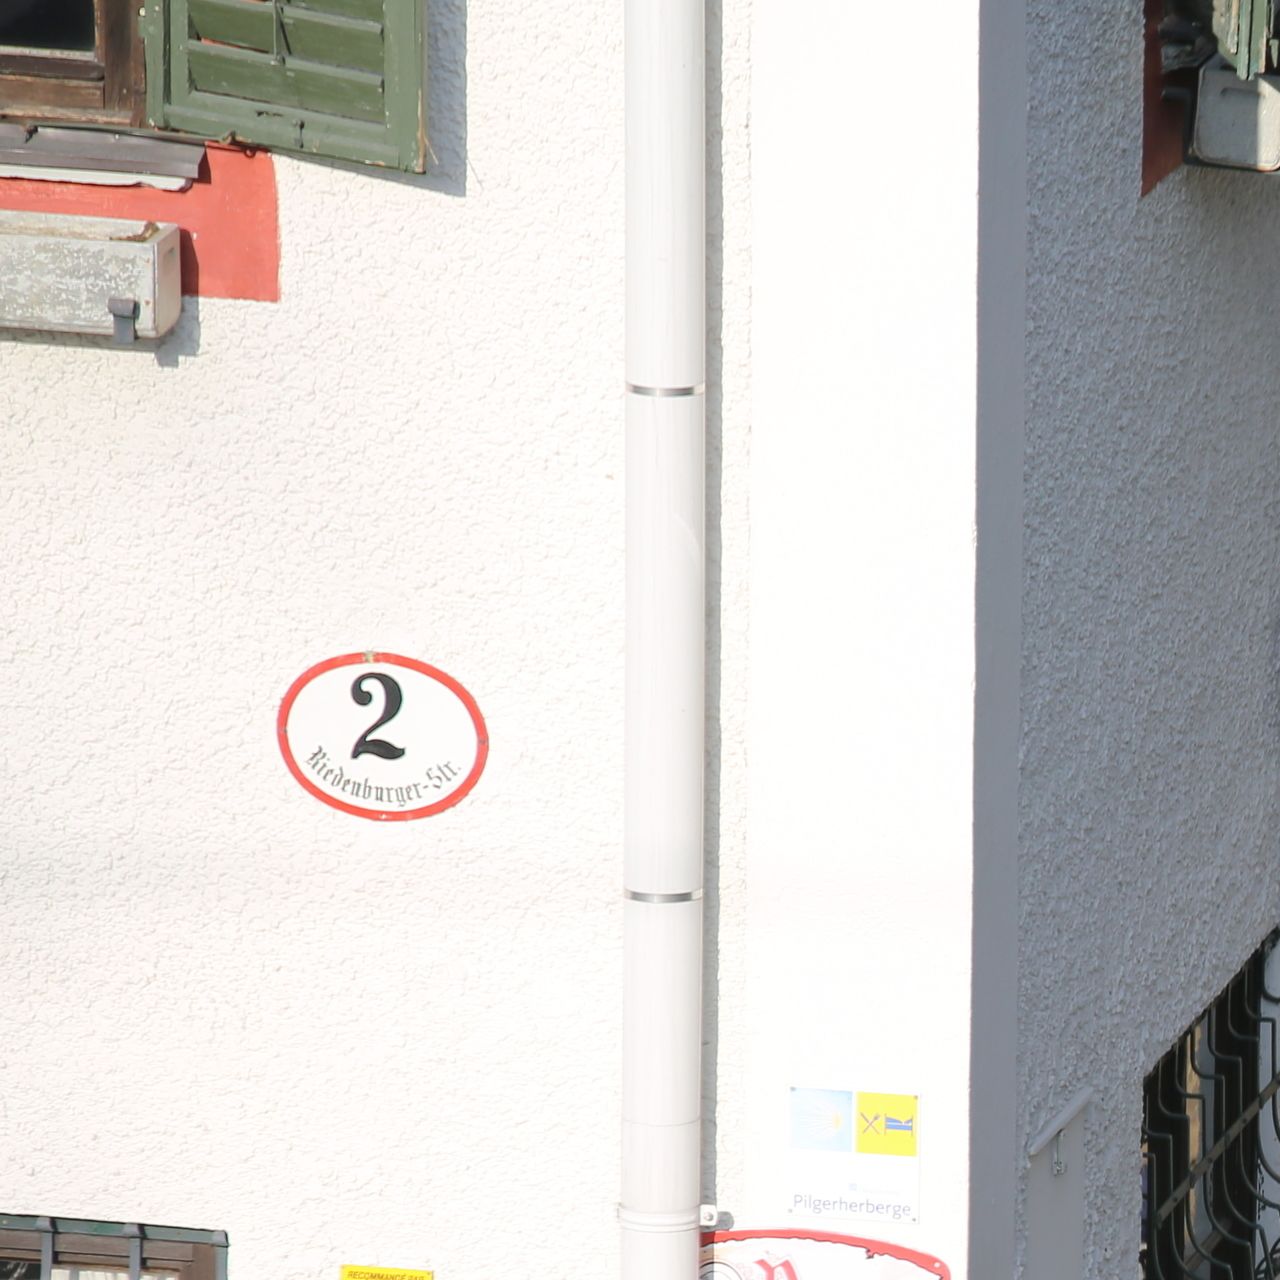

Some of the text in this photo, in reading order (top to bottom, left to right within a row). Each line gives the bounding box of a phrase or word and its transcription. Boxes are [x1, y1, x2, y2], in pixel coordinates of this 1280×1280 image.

[351, 672, 406, 760] 2
[305, 745, 462, 807] Riedenburger-Str.
[793, 1194, 912, 1219] Pilgerherberge
